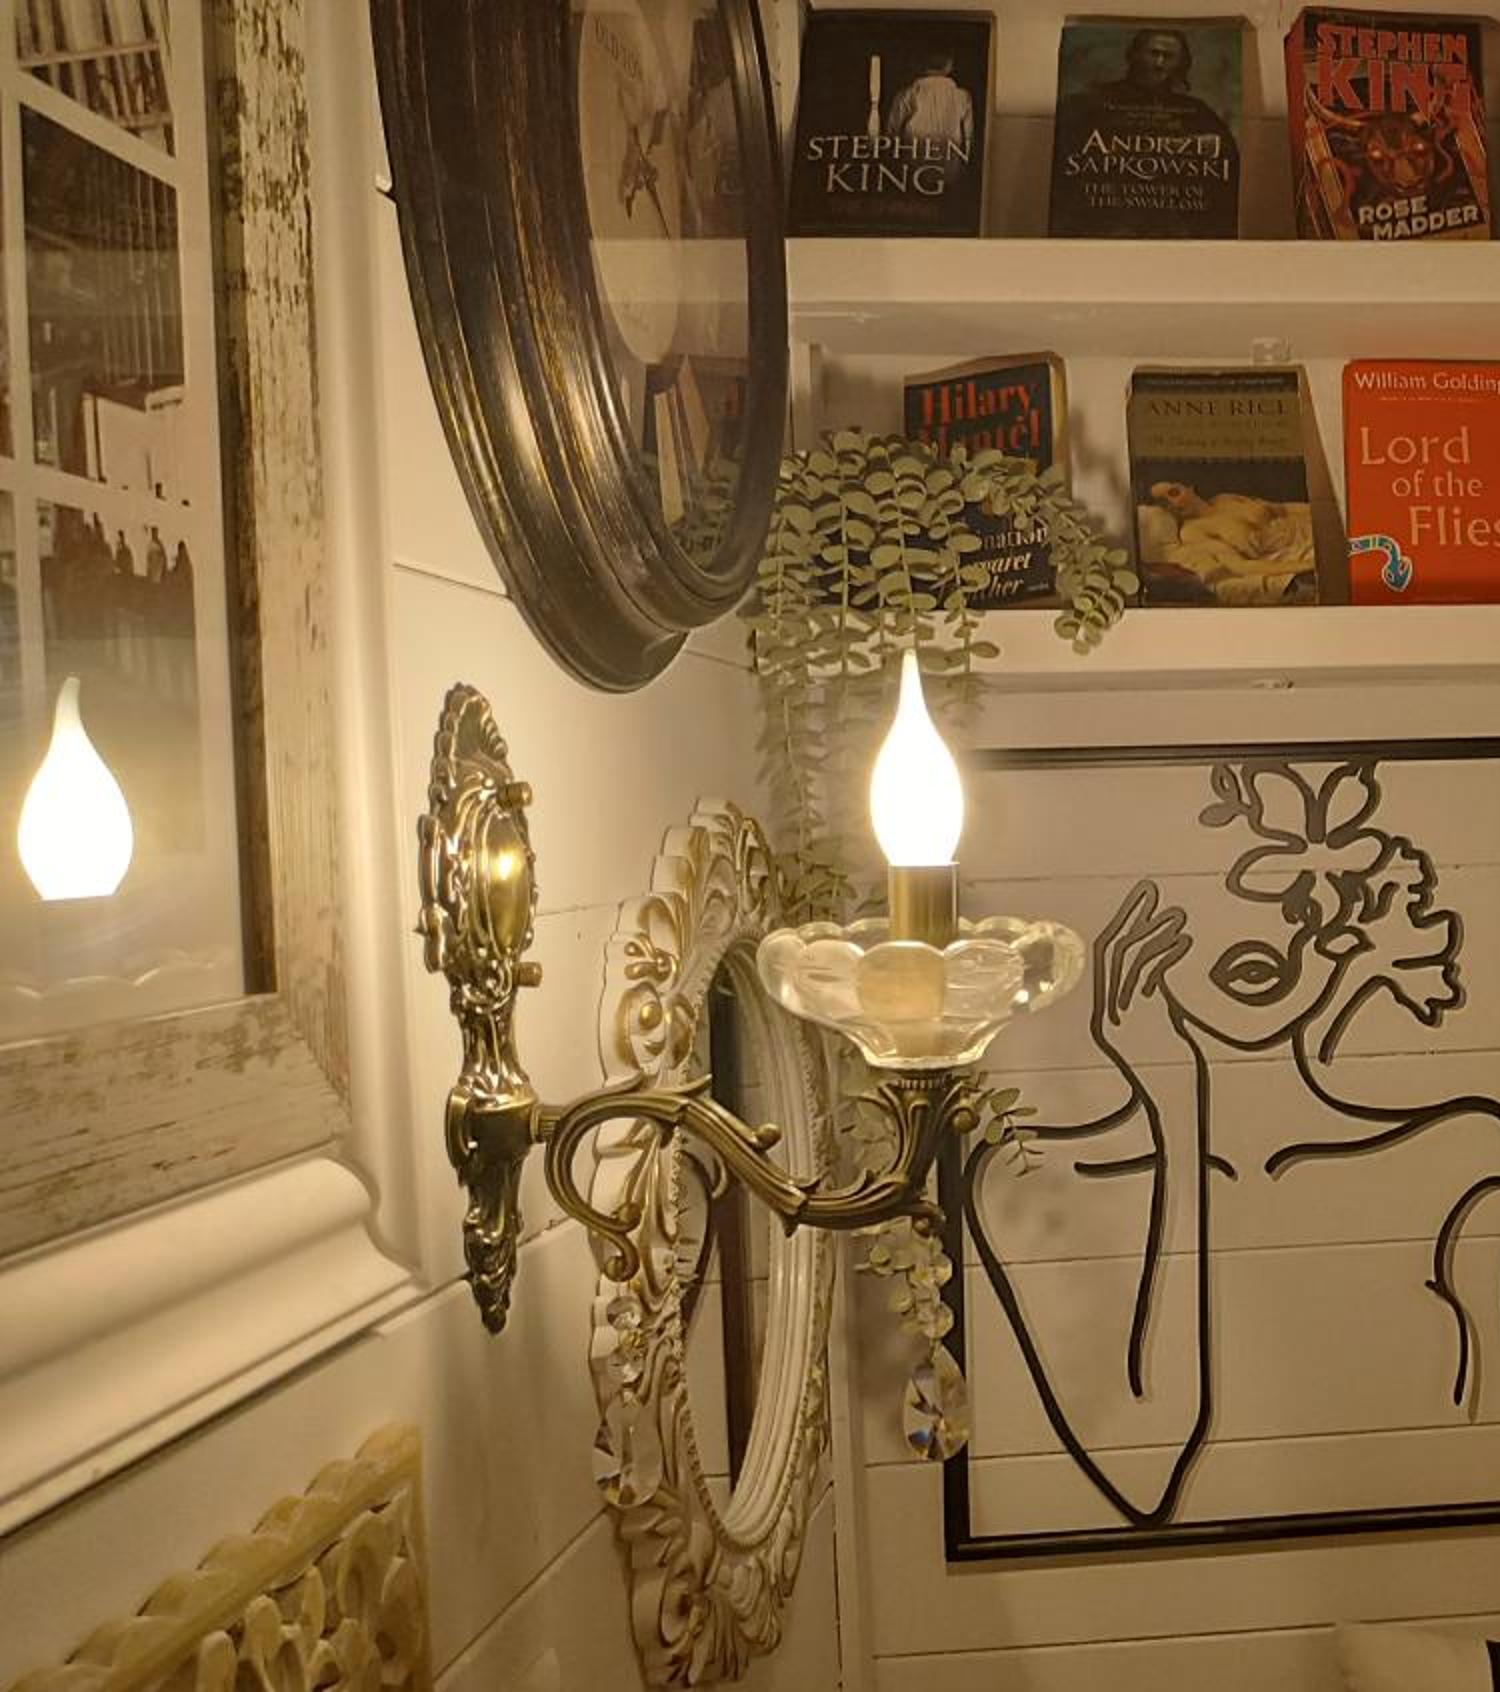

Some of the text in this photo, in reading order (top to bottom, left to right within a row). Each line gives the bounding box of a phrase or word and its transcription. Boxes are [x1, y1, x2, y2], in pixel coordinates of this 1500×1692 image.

[1317, 24, 1469, 63] STEPHEN
[807, 135, 971, 163] STEPHEN
[1082, 129, 1221, 158] ANDRZEJ
[826, 163, 945, 195] KING
[1065, 156, 1230, 182] SAPKOWSKI
[1358, 195, 1429, 225] ROSE
[1373, 204, 1480, 239] MADDER
[1355, 371, 1427, 390] William
[922, 382, 1032, 425] Hilary
[1360, 426, 1471, 465] Lord
[1391, 468, 1484, 497] of the
